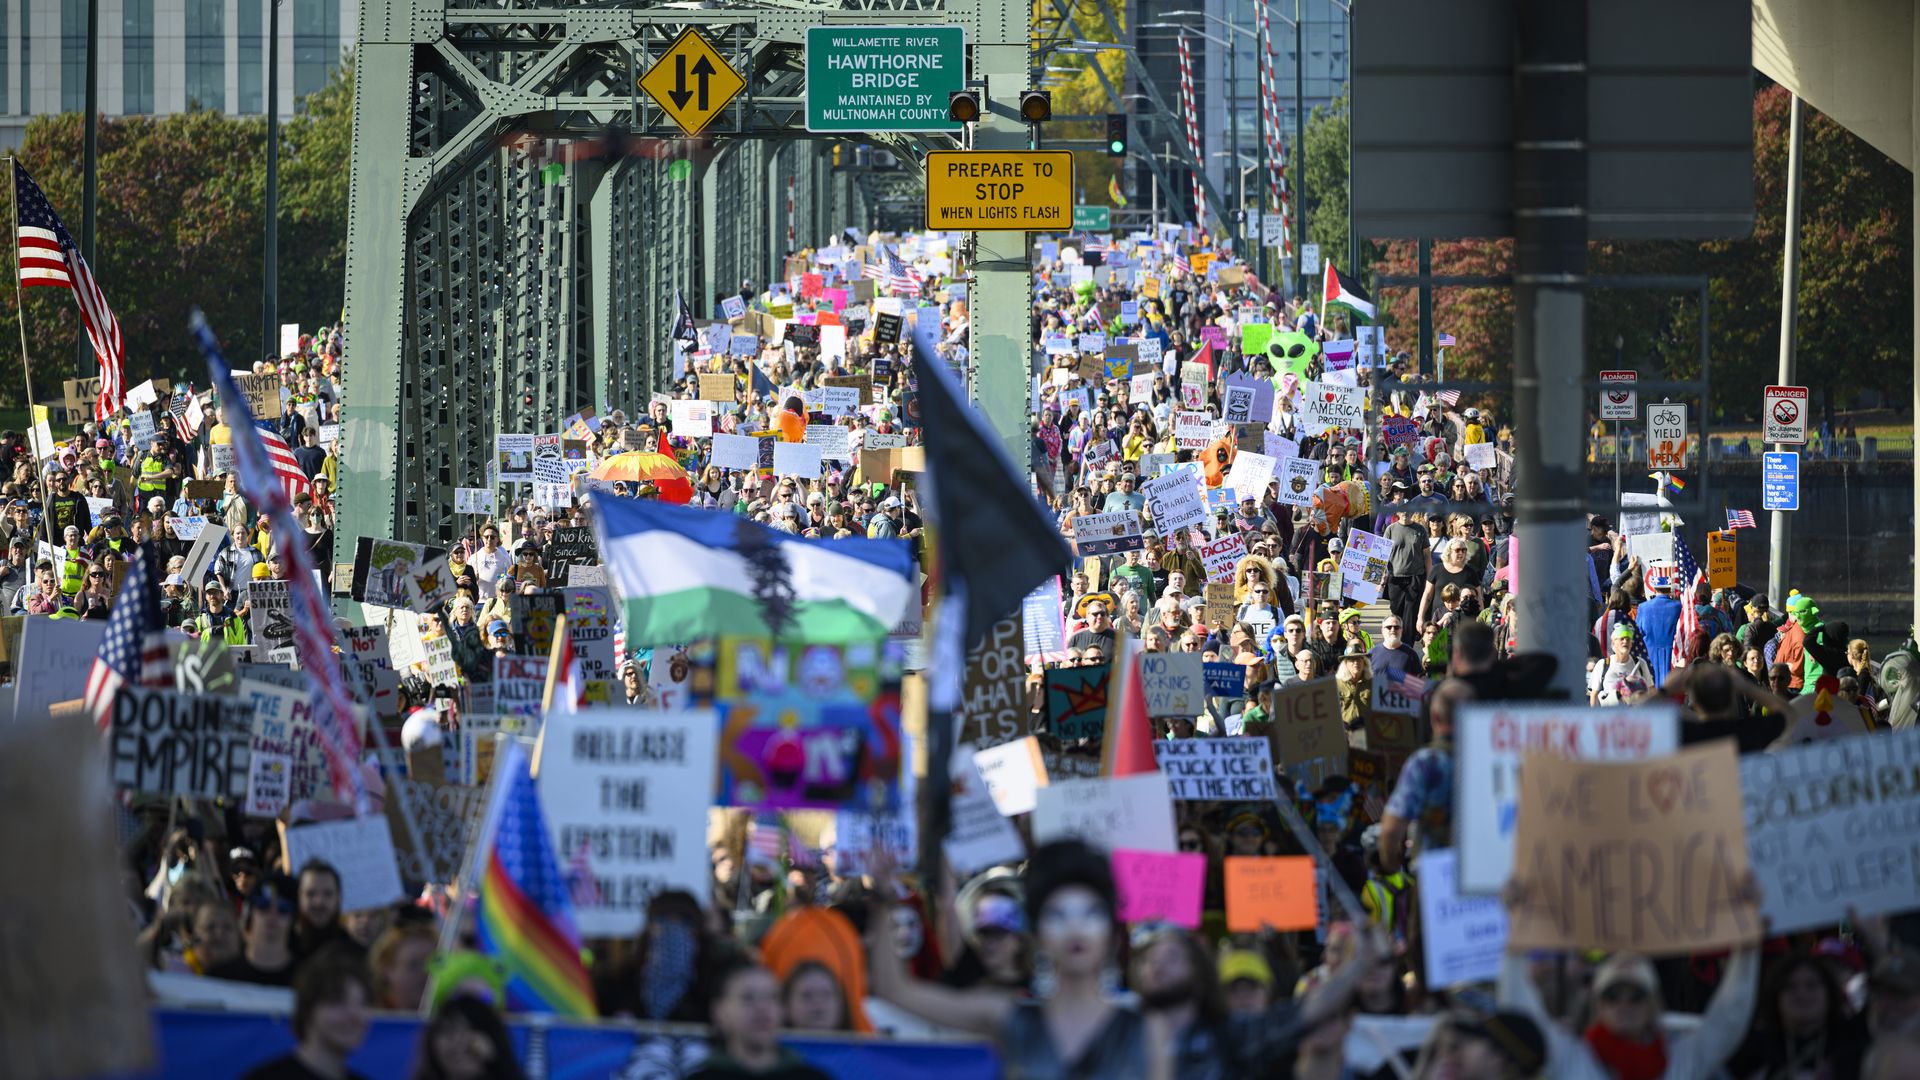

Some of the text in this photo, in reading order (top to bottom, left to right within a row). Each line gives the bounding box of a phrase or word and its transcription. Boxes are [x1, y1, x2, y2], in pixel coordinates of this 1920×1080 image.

[832, 38, 939, 47] WILLAMETTE RIVER
[828, 54, 944, 70] HAWTHORNE
[852, 73, 920, 88] BRIDGE
[838, 94, 932, 106] MAINTAINED BY
[823, 108, 948, 120] MULTNOMAH COUNTY
[948, 162, 1053, 178] PREPARE TO
[976, 184, 1025, 200] STOP
[940, 207, 1060, 219] WHEN LIGHTS FLASH
[1232, 391, 1250, 399] DON'T
[1774, 390, 1805, 398] DANGER
[1309, 402, 1362, 418] AMERICA
[1318, 416, 1352, 426] PROTEST
[1388, 424, 1414, 436] OUR
[1654, 428, 1681, 438] YIELD
[536, 436, 559, 445] DON'T
[873, 438, 894, 446] Good
[1662, 440, 1673, 450] TO
[535, 458, 563, 466] ESPAIR
[1086, 451, 1096, 462] NO
[1656, 454, 1680, 464] PEDS
[1766, 456, 1782, 464] There
[1290, 468, 1314, 476] PREVENT
[1144, 474, 1190, 502] INHUMANE
[1151, 492, 1194, 517] COWARDLY
[1284, 494, 1309, 502] FASCISM
[1076, 512, 1132, 526] DETHRONE
[1155, 508, 1203, 534] EXTREMISTS
[560, 533, 575, 543] NO
[1200, 534, 1246, 558] FACISM
[555, 548, 578, 557] since
[1714, 546, 1726, 554] USA
[1212, 554, 1233, 566] in the
[1218, 561, 1234, 574] NO
[1342, 560, 1366, 573] RESIST
[251, 599, 288, 609] SNAKE
[343, 626, 380, 638] We Are
[424, 637, 448, 653] POWER
[428, 651, 452, 666] OF THE
[964, 645, 1022, 683] FOR
[1143, 658, 1167, 675] NO
[176, 653, 204, 696] IS
[432, 667, 456, 684] PEOPLE
[250, 690, 281, 717] THE
[961, 676, 1024, 715] WHAT
[114, 688, 220, 732] DOWN
[1285, 690, 1328, 723] ICE
[262, 719, 285, 738] THE
[973, 708, 1020, 738] IS
[1593, 715, 1651, 757] YOU
[572, 727, 688, 767] RELEASE
[1154, 740, 1265, 756] FUCK TRUMP
[111, 731, 249, 797] EMPIRE
[1166, 759, 1254, 775] FUCK ICE
[1354, 760, 1374, 772] NO
[599, 774, 648, 814] THE
[1195, 778, 1228, 797] THE
[1231, 778, 1274, 797] RICH
[1536, 770, 1599, 826] WE
[1743, 772, 1876, 831] GOLDEN
[560, 825, 678, 862] EPSTEIN
[1803, 821, 1832, 855] A
[1516, 832, 1752, 946] AMERICA
